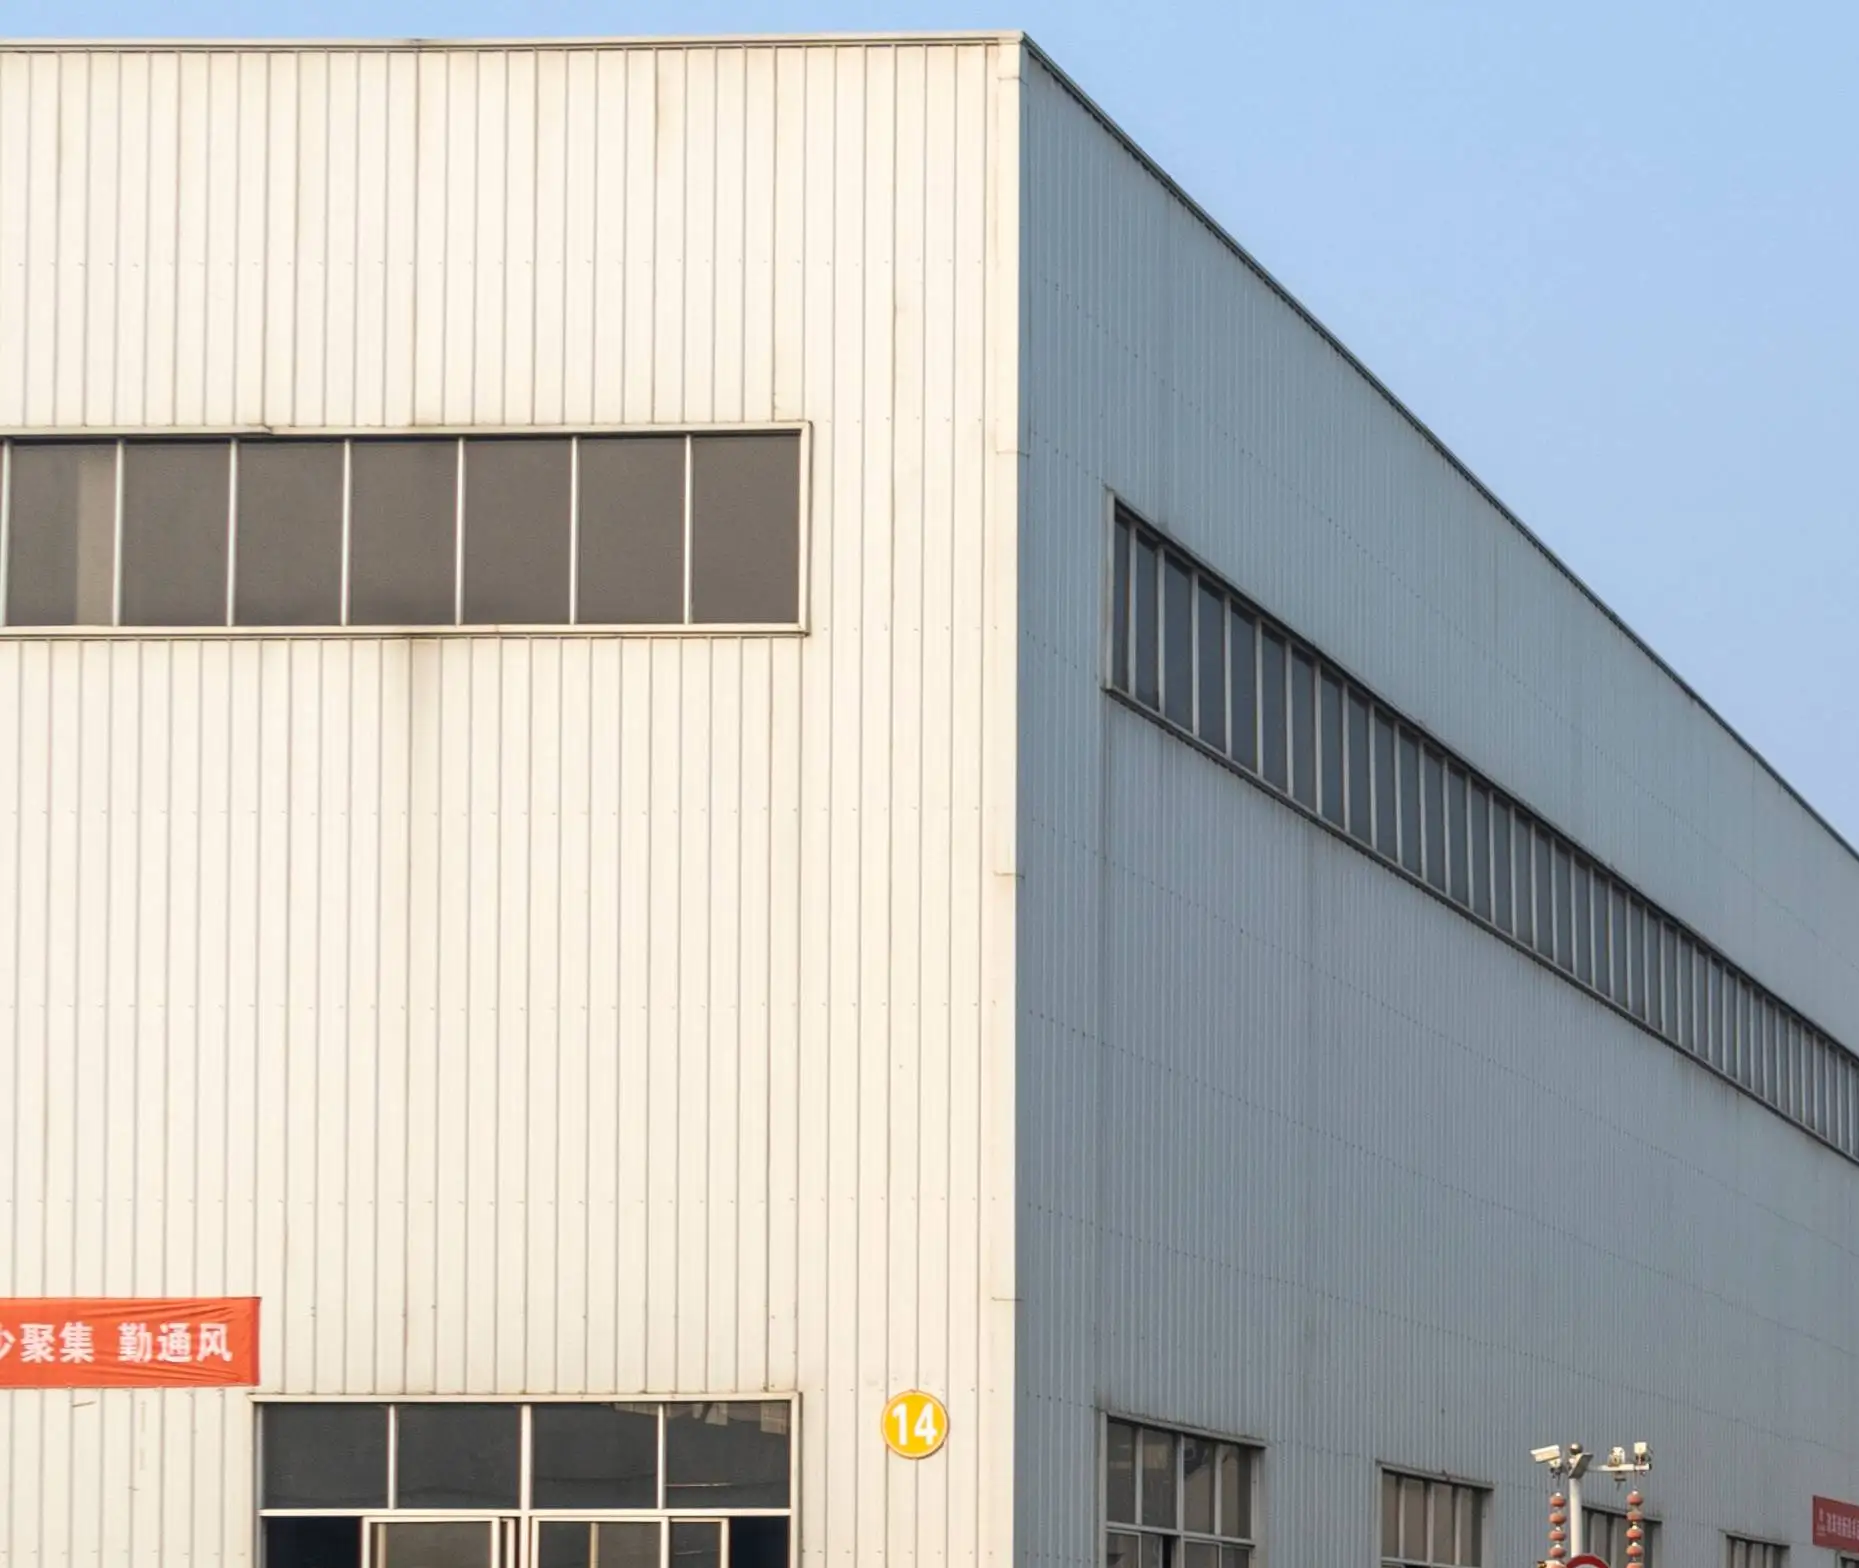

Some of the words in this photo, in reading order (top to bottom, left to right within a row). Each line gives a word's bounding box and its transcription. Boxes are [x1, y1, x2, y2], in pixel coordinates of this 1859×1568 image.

[117, 1321, 233, 1363] 勤通风
[891, 1402, 938, 1446] 14
